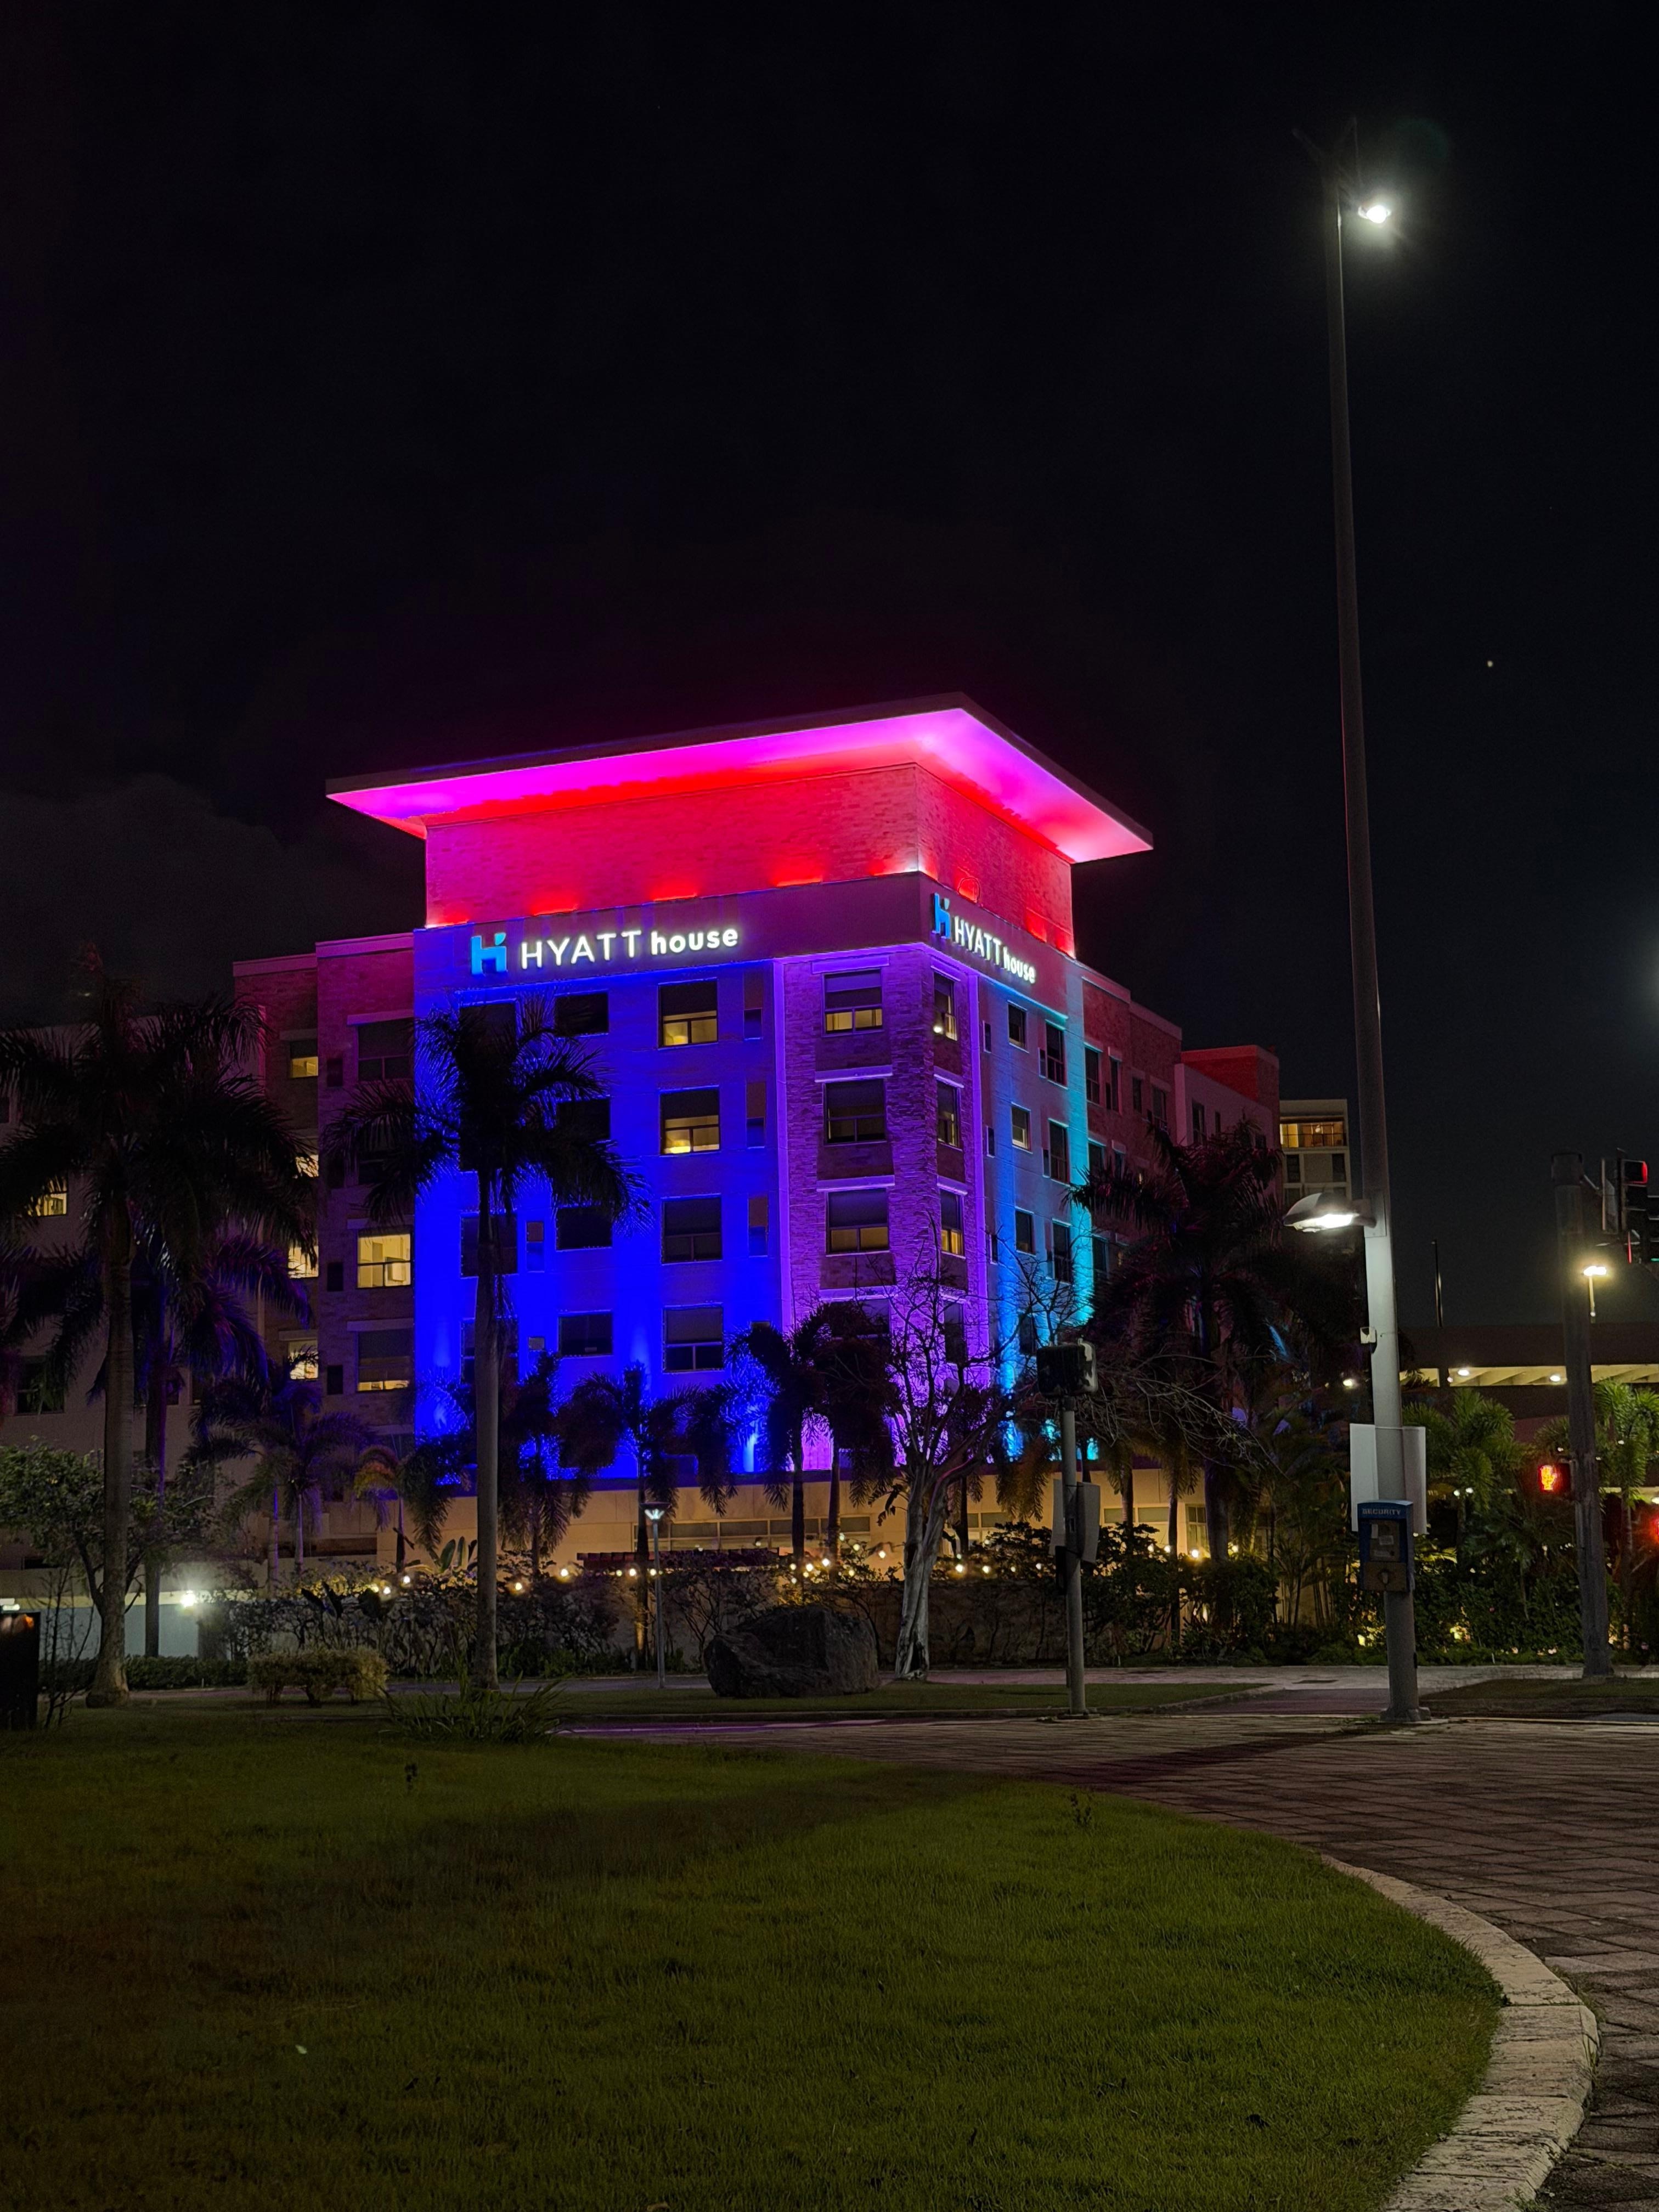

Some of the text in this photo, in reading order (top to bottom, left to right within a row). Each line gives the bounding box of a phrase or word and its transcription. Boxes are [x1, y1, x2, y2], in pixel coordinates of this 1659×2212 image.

[521, 930, 642, 969] HYATT
[651, 928, 738, 956] house
[954, 916, 1002, 966] HYATT
[1003, 946, 1036, 984] house
